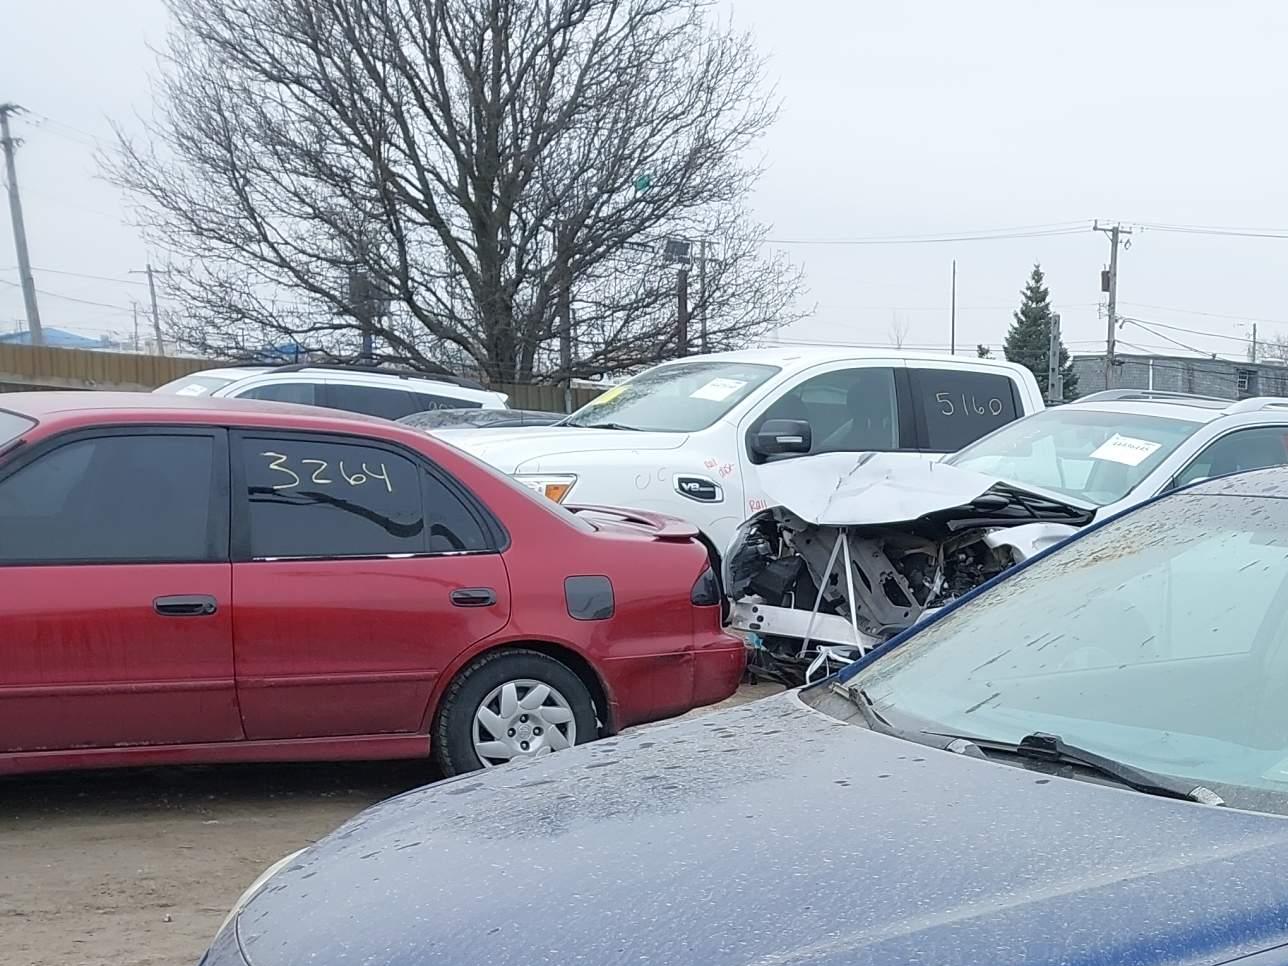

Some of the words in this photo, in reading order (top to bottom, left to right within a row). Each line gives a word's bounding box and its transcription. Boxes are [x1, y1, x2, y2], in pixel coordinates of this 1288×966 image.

[935, 392, 1002, 416] 5160
[260, 452, 393, 492] 3264
[681, 482, 700, 491] V8
